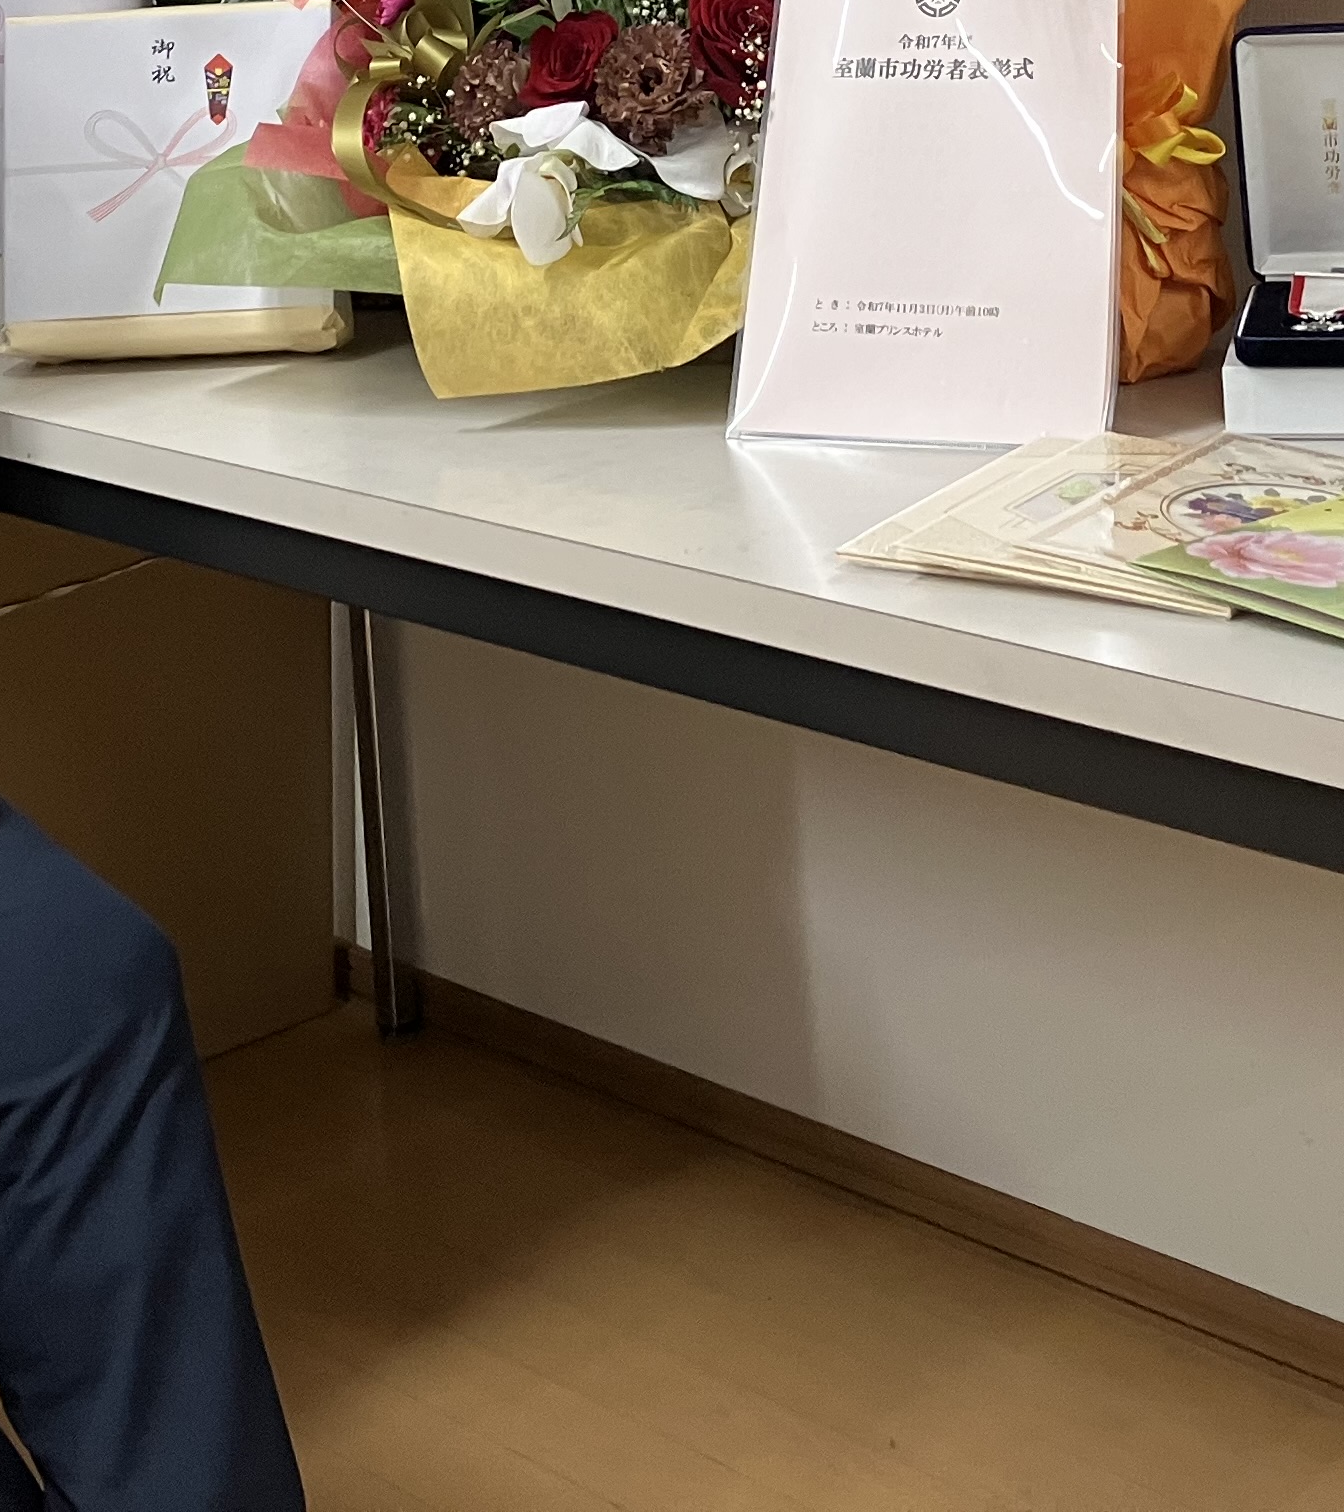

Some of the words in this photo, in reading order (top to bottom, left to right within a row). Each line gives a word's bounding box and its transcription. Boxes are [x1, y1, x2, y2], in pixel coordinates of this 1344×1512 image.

[151, 39, 175, 83] 御祝
[833, 56, 1035, 80] 室蘭市功労者表彰式
